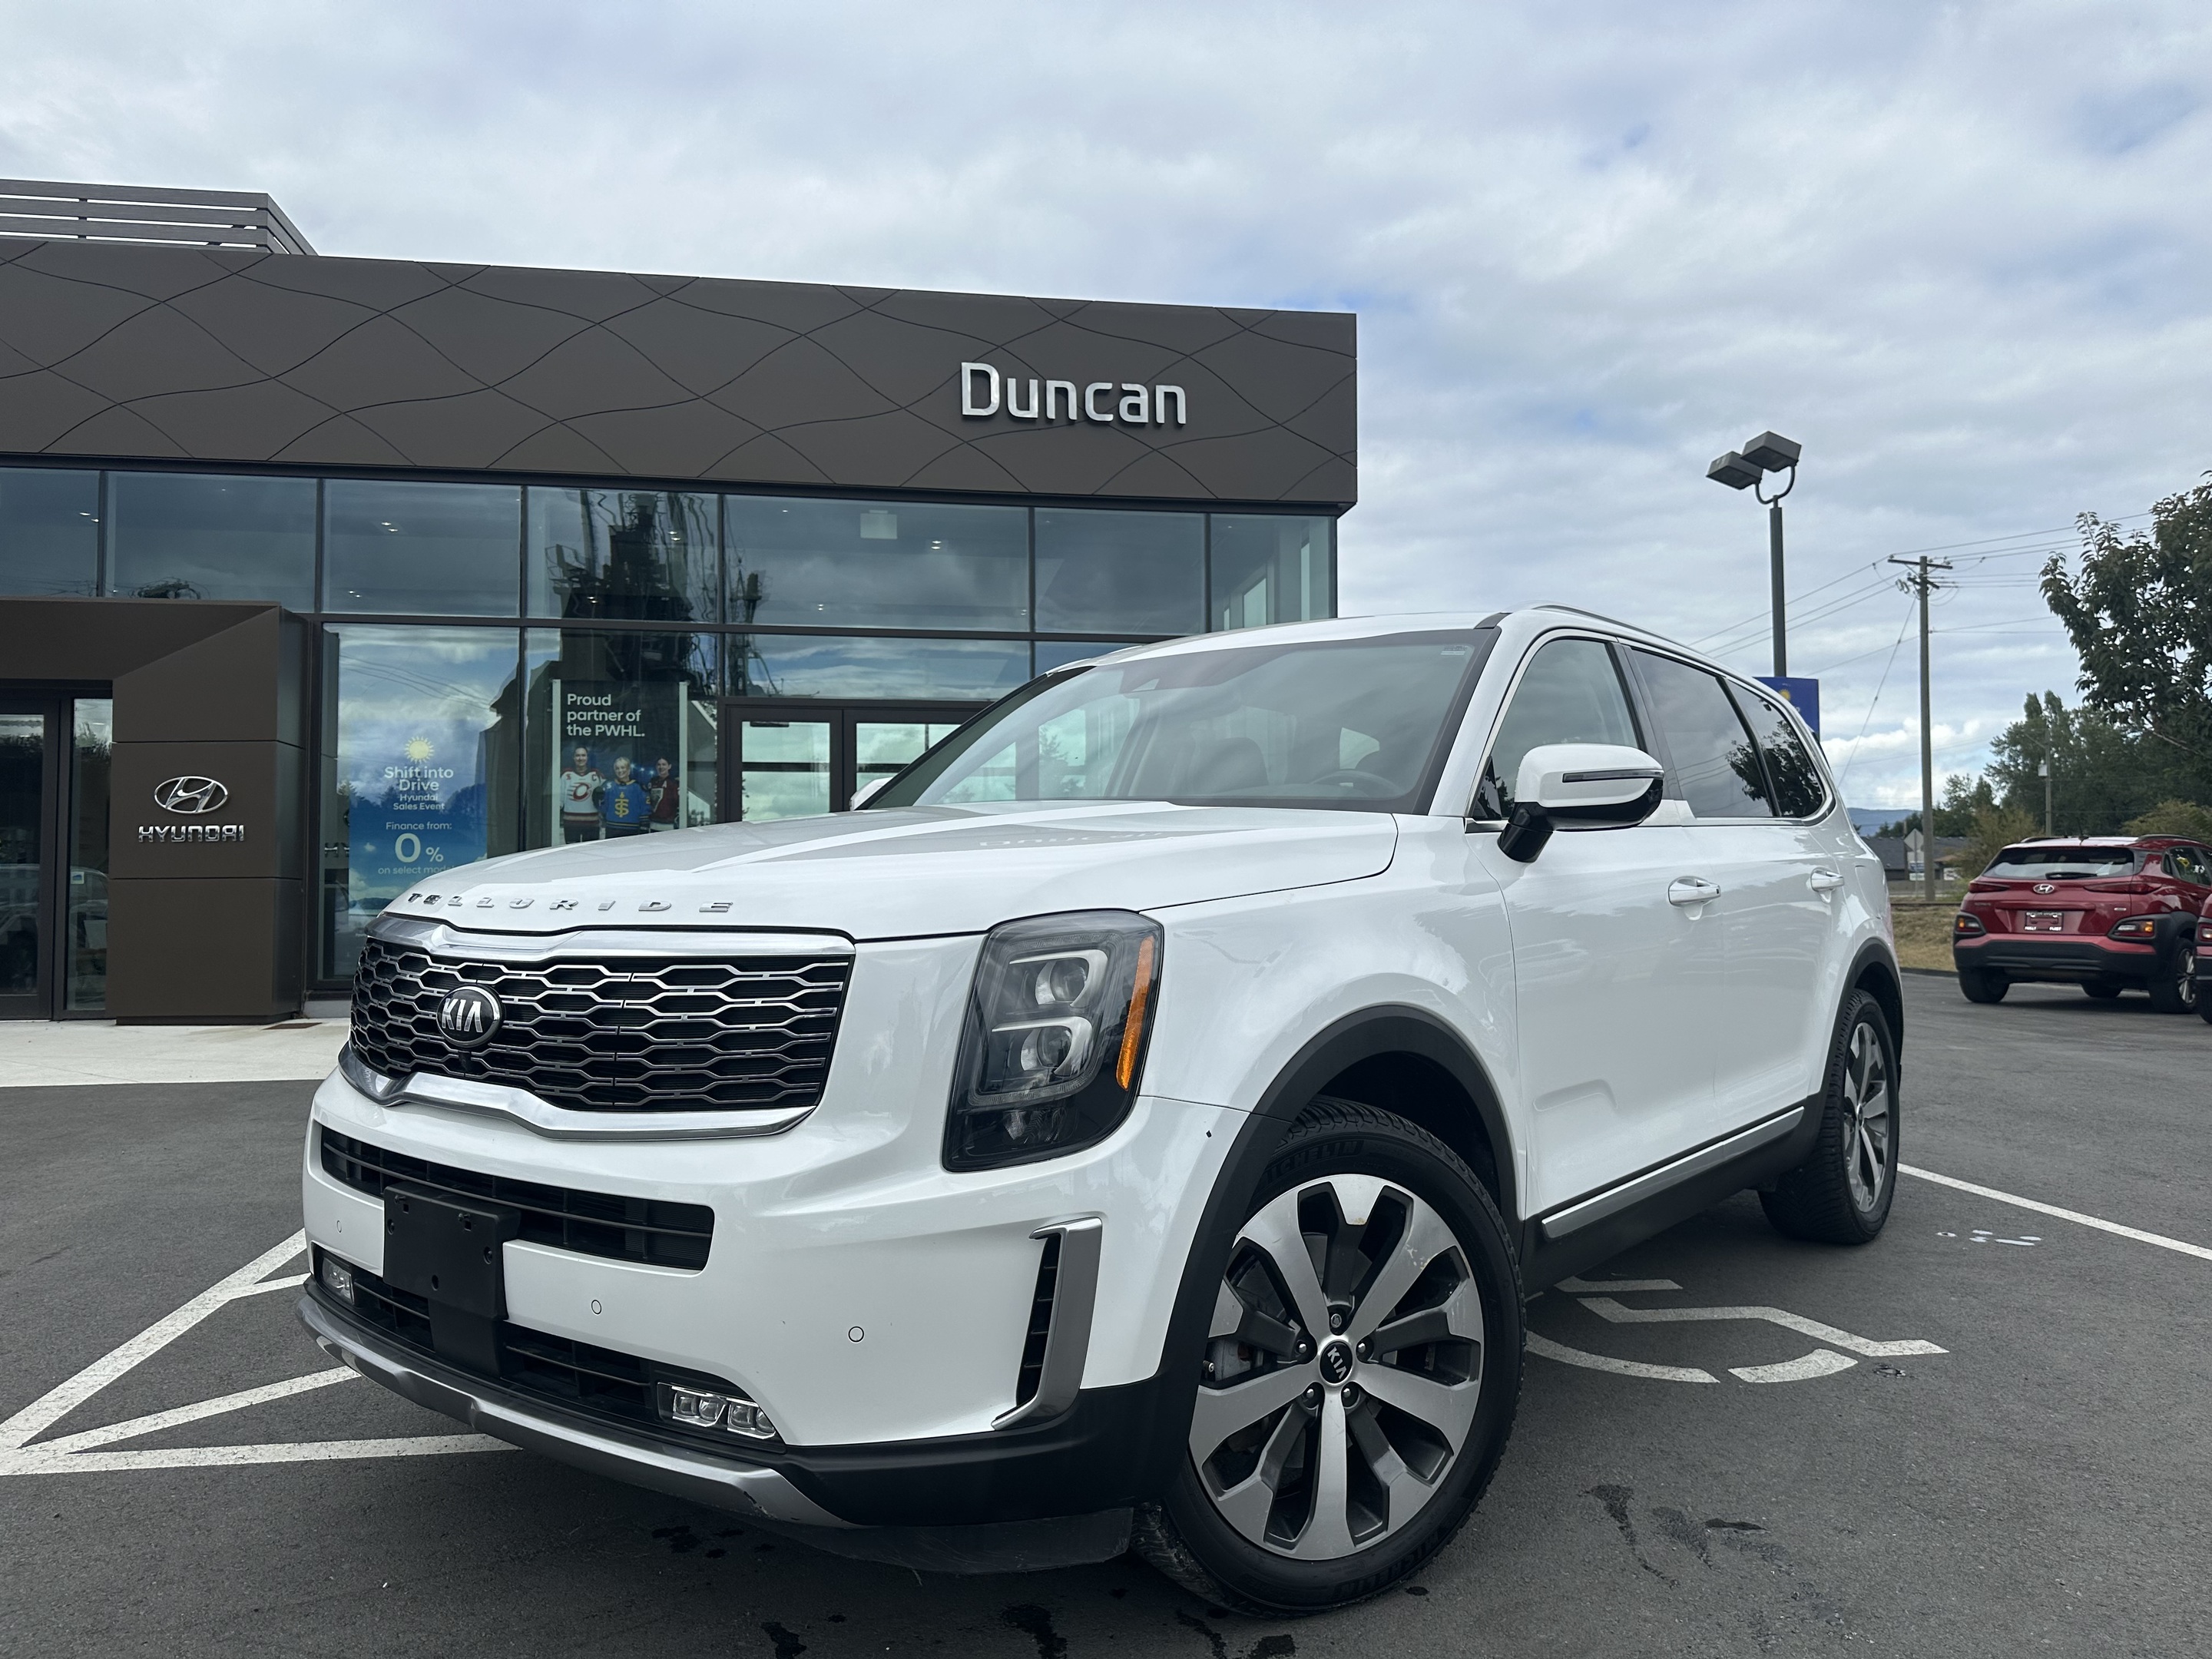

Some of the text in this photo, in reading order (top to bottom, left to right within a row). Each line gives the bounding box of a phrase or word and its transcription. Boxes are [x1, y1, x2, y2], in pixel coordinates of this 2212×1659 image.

[961, 362, 1186, 424] Duncan
[567, 693, 611, 706] Proud
[567, 709, 641, 723] partner of
[567, 724, 645, 737] the PWHL.
[384, 767, 454, 778] Shift into
[399, 779, 439, 791] Drive
[399, 793, 438, 803] Hyundai
[386, 821, 452, 830] Finance from:
[138, 825, 244, 843] HYUNDAI
[426, 846, 444, 863] %
[392, 866, 420, 875] select
[406, 892, 734, 913] TELLURIDE
[442, 998, 483, 1033] KIA
[1327, 1346, 1347, 1380] KIA
